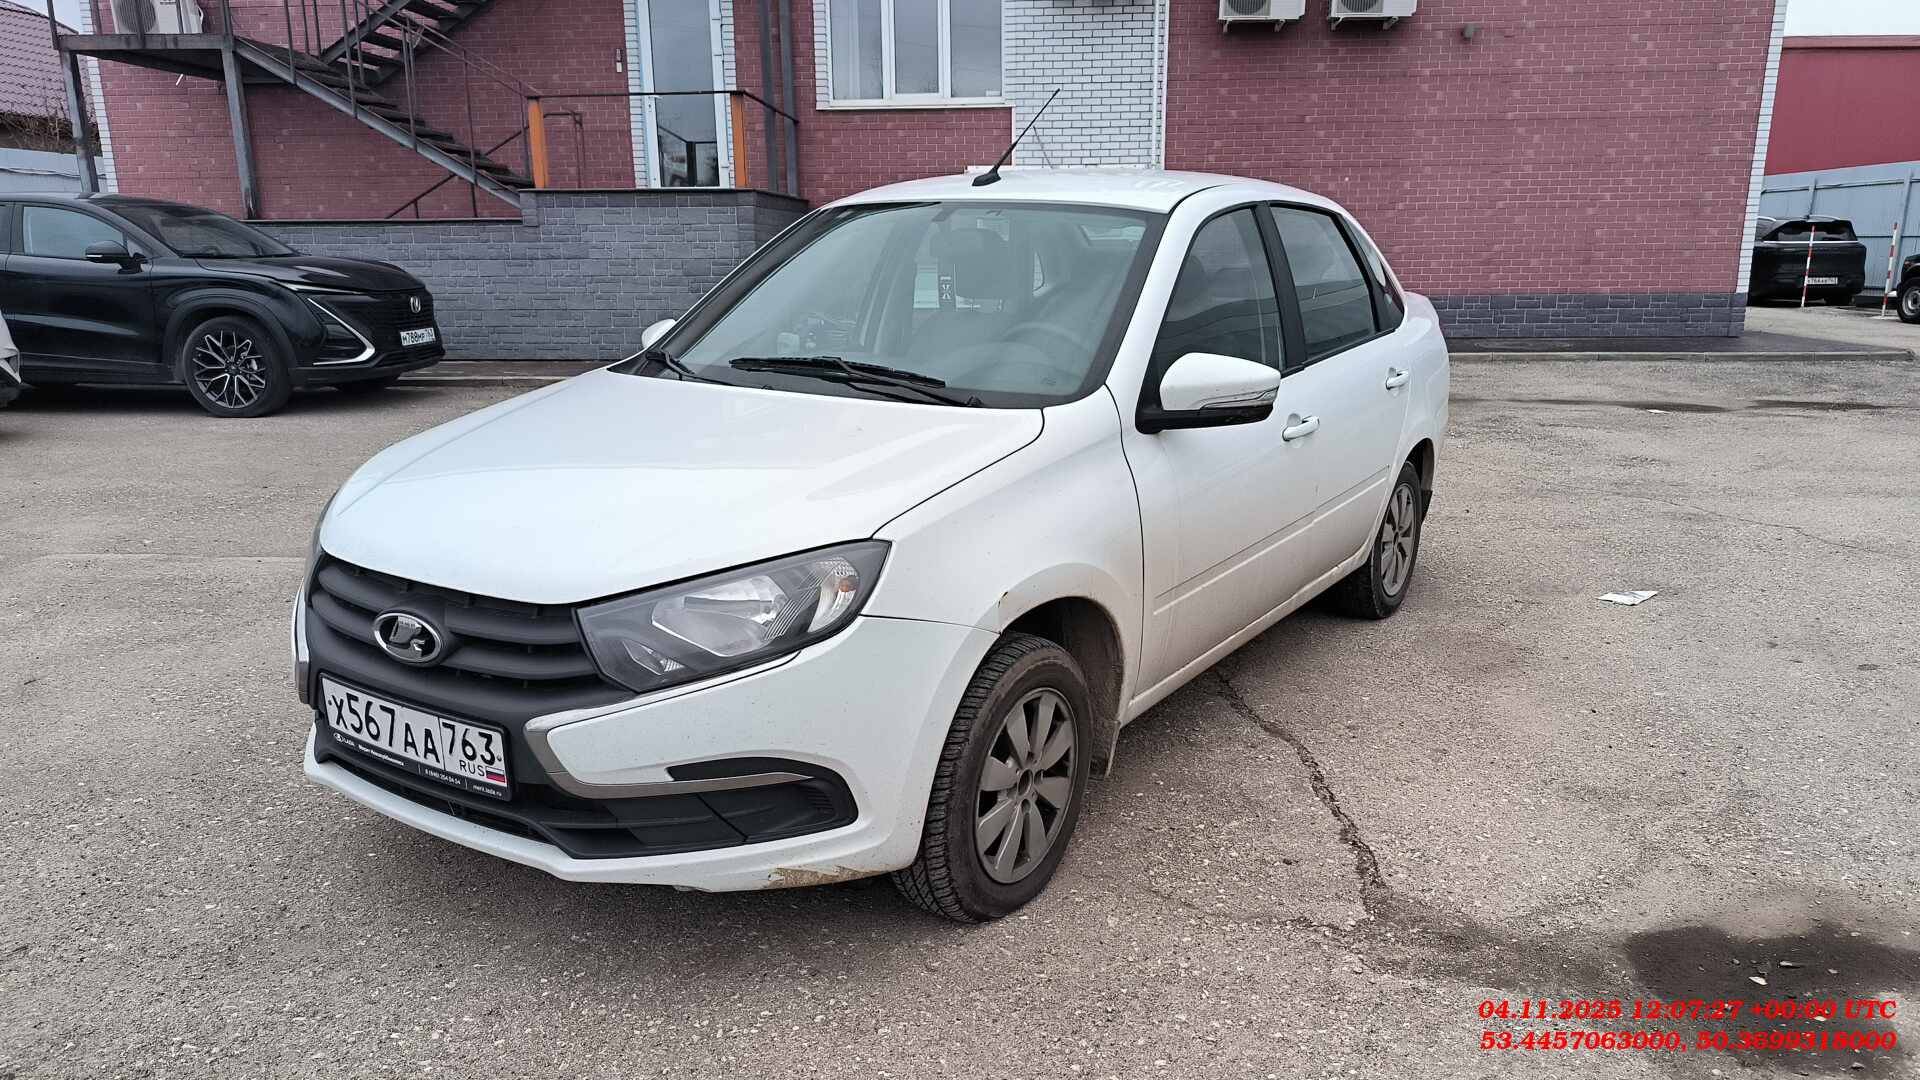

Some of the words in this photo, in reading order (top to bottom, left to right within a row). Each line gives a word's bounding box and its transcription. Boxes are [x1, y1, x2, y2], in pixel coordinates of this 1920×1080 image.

[331, 692, 440, 763] Х567АА
[442, 722, 496, 765] 763
[459, 760, 486, 776] RUS
